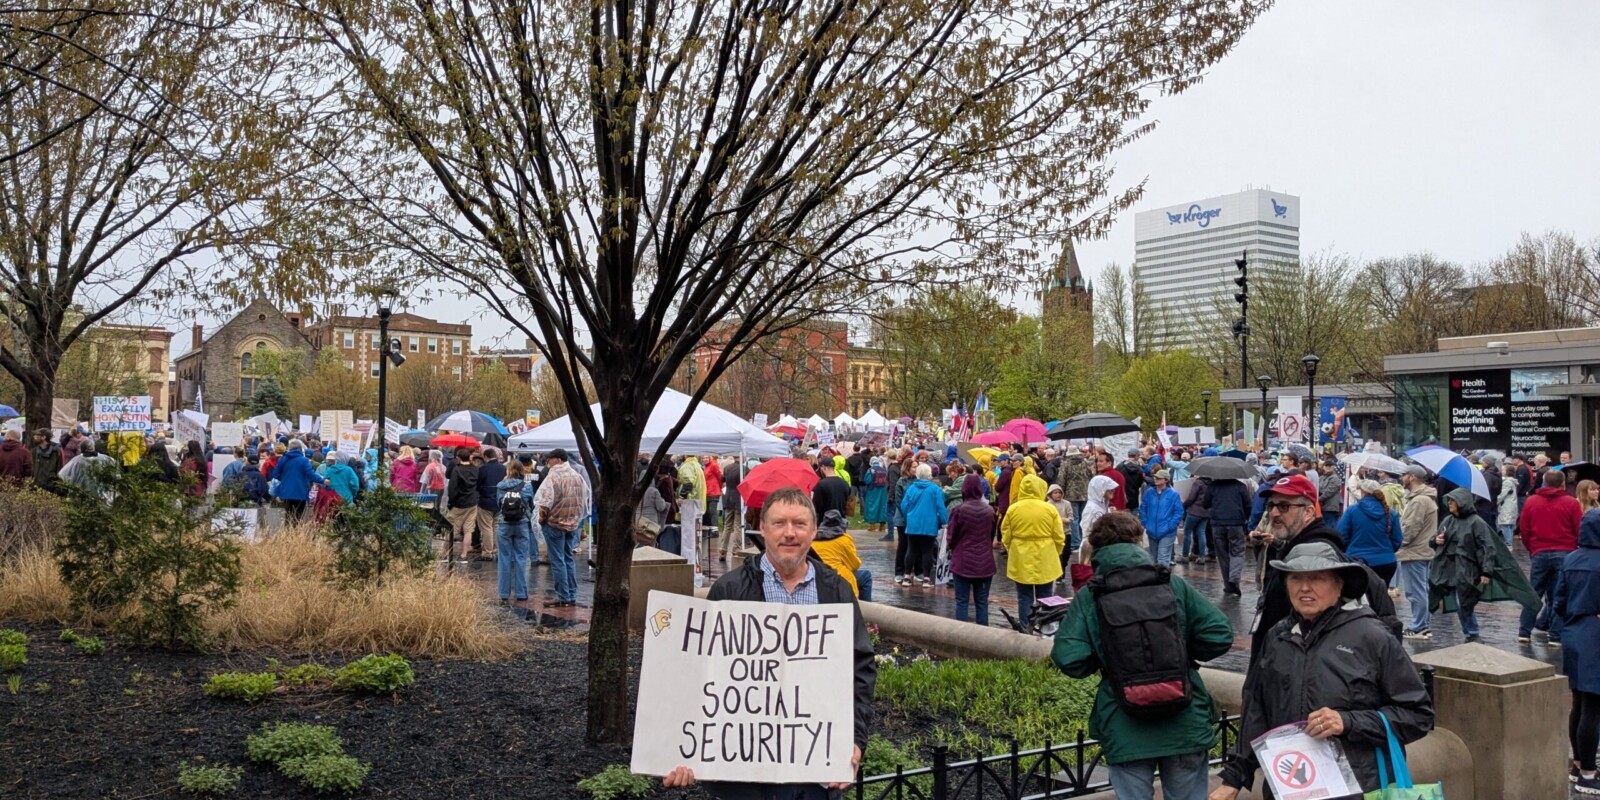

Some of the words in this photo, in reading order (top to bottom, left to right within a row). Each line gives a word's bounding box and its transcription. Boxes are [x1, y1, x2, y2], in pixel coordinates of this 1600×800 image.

[1184, 204, 1222, 227] Kroger
[1461, 379, 1486, 387] Health
[94, 397, 118, 405] THIS
[127, 396, 138, 405] IS
[101, 404, 147, 413] EXACTLY
[1452, 407, 1483, 416] Defying
[1483, 406, 1506, 415] odds.
[94, 413, 116, 422] HOW
[121, 413, 151, 422] PUTIN
[1452, 416, 1494, 425] Redefining
[100, 421, 147, 430] STARTED
[1453, 426, 1471, 435] your
[1472, 425, 1499, 433] future.
[729, 658, 780, 682] OUR
[702, 681, 811, 719] SOCIAL
[679, 721, 832, 766] SECURITY!
